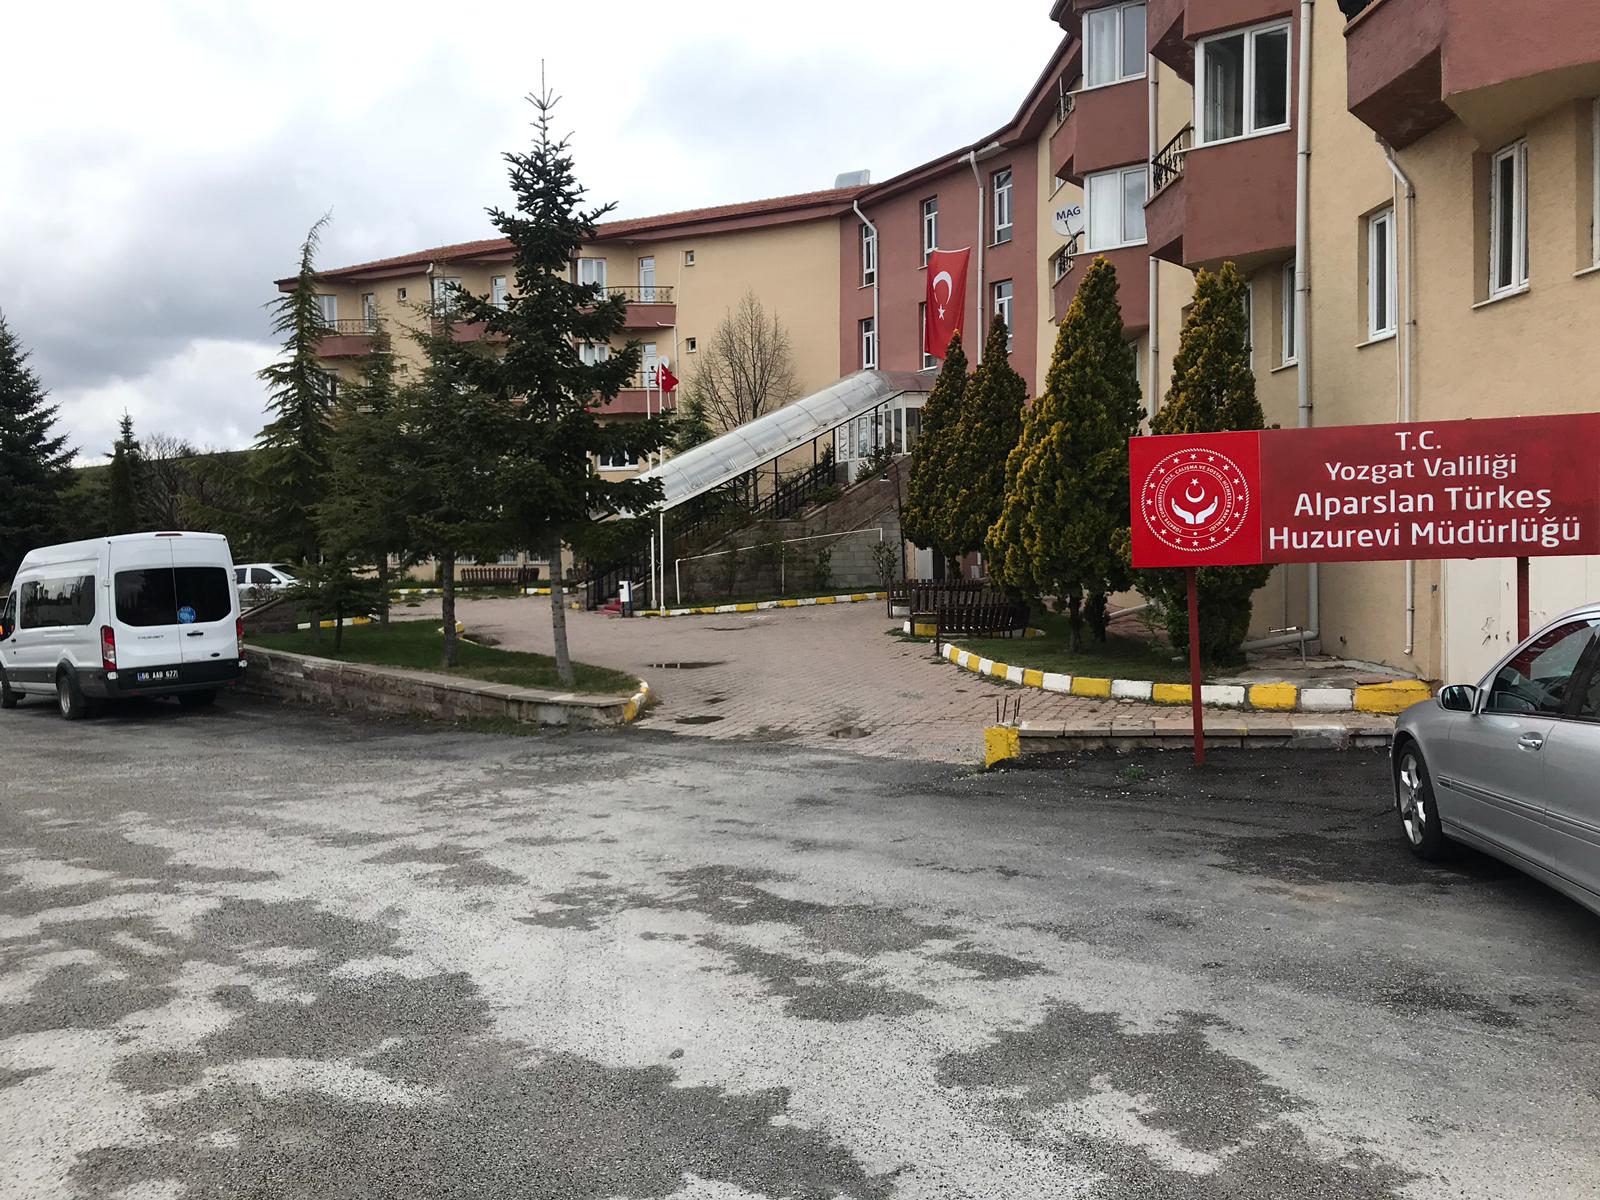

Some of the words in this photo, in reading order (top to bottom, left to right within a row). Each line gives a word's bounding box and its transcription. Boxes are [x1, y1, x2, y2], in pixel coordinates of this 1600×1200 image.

[1056, 206, 1081, 220] MAG
[1395, 430, 1442, 451] T.C.
[1325, 461, 1414, 484] Yozgat
[1423, 453, 1517, 480] Valiliği
[1294, 489, 1434, 521] Alparslan
[1444, 485, 1552, 514] Türkeş
[1269, 522, 1400, 550] Huzurevi
[1411, 516, 1580, 548] Müdürlüğü
